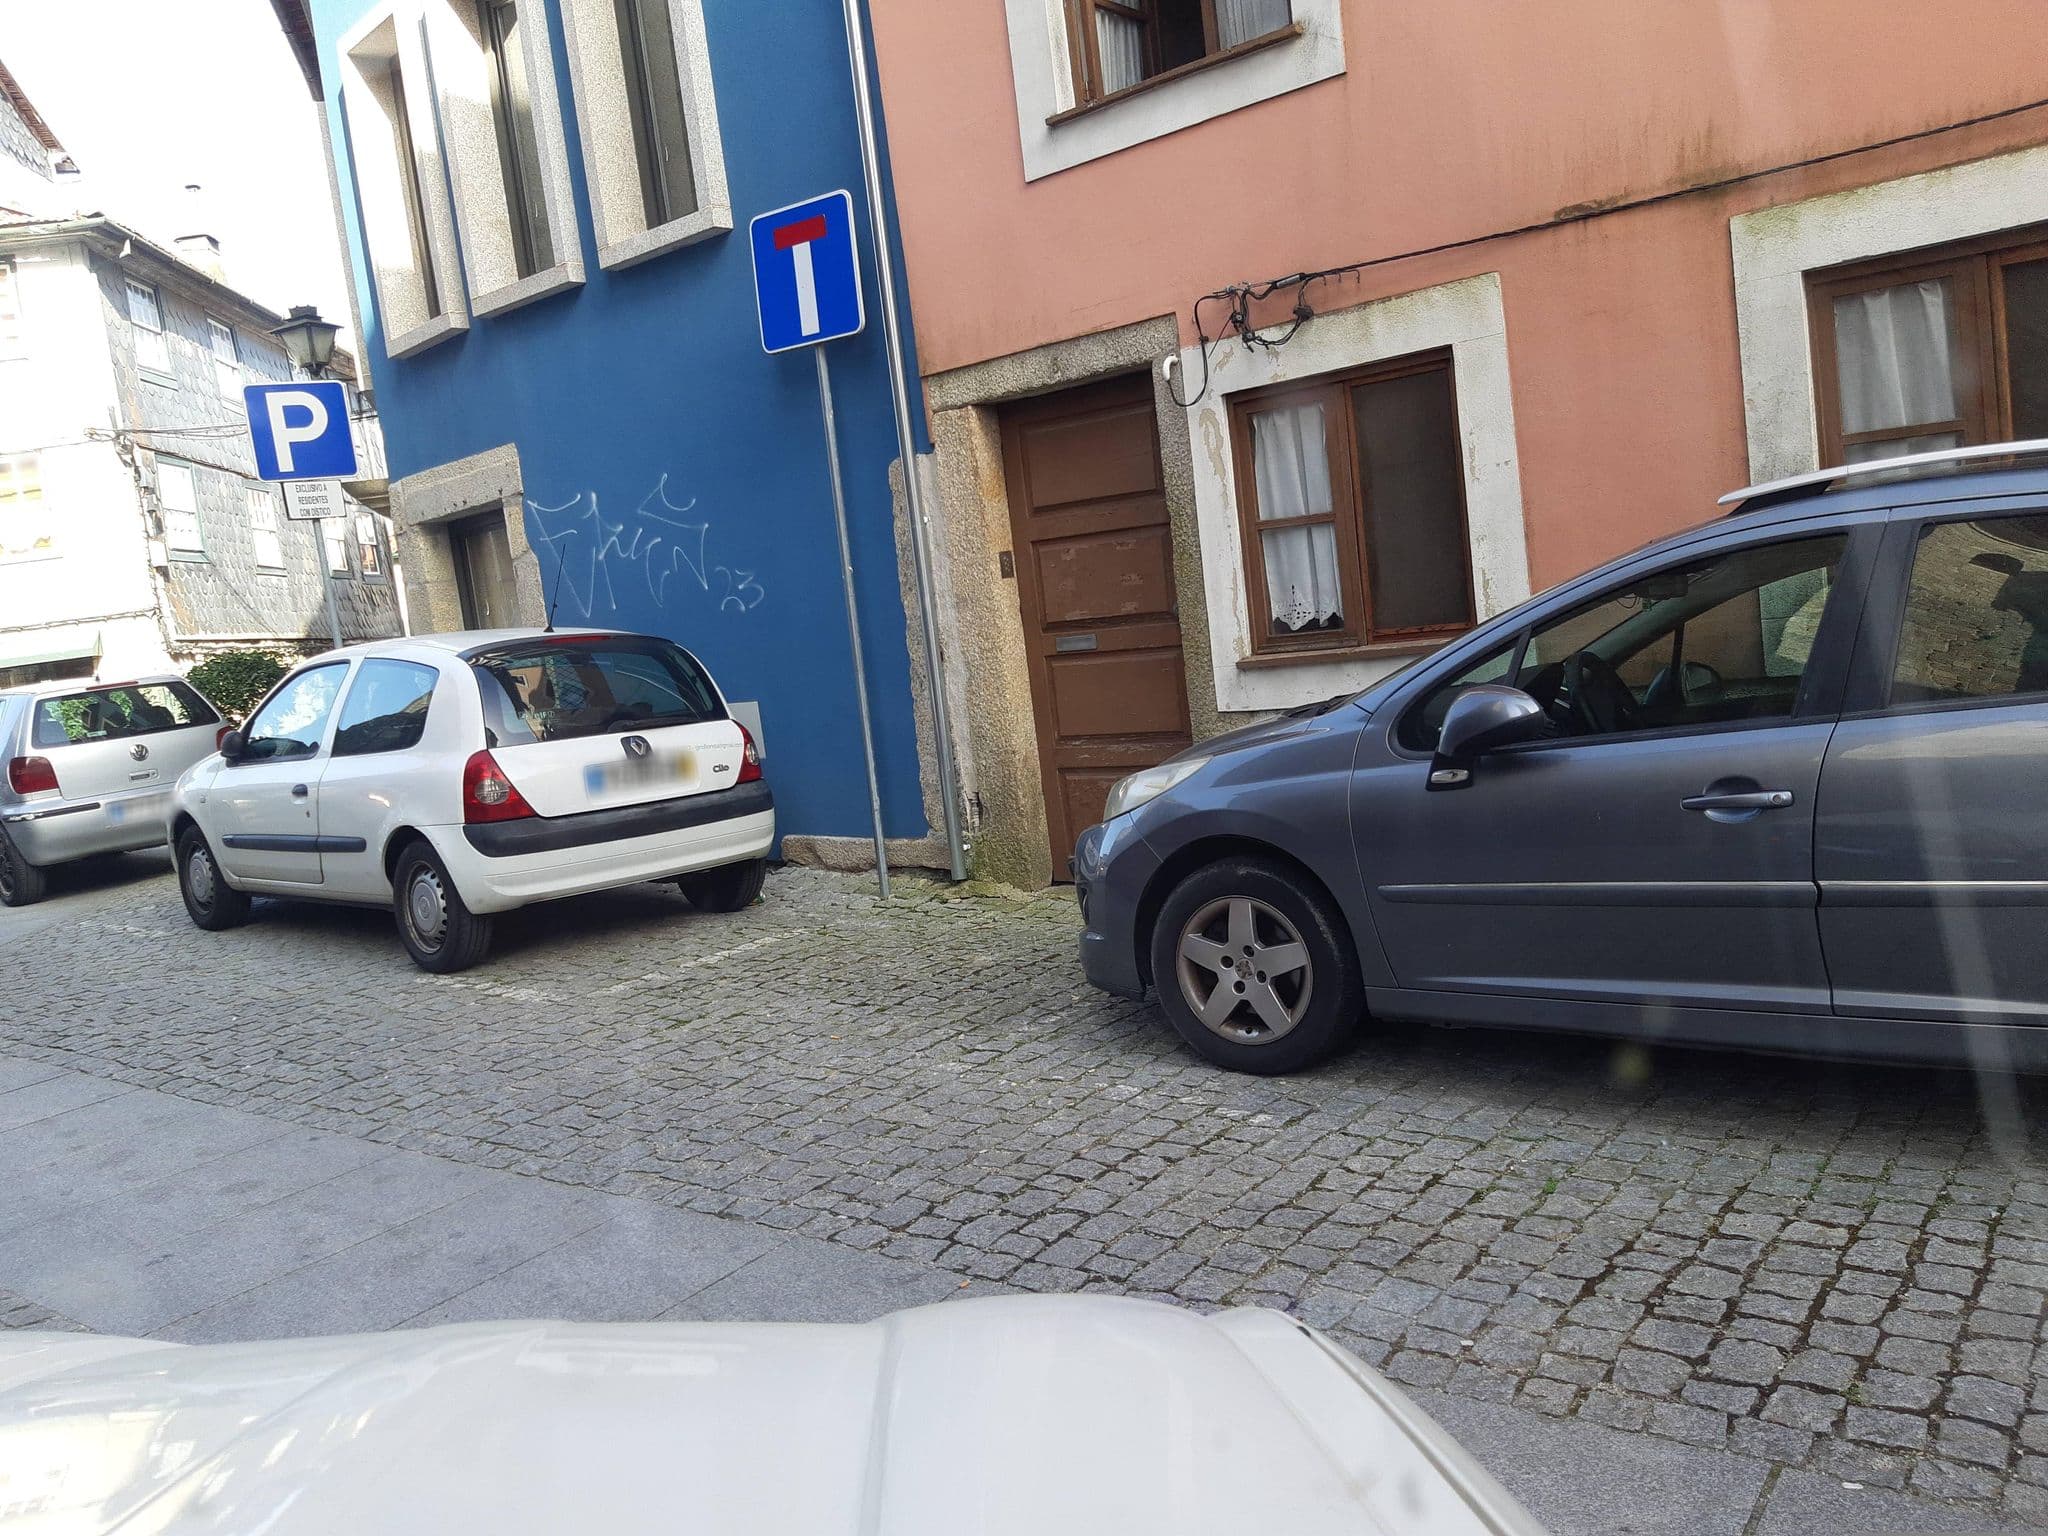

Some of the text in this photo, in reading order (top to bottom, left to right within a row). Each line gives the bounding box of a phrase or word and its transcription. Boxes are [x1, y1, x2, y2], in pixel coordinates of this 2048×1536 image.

[265, 391, 328, 472] P
[295, 484, 323, 493] EXCLUSIVO
[298, 495, 329, 505] RESIDENTES
[300, 508, 311, 517] COM
[712, 764, 730, 773] Clio
